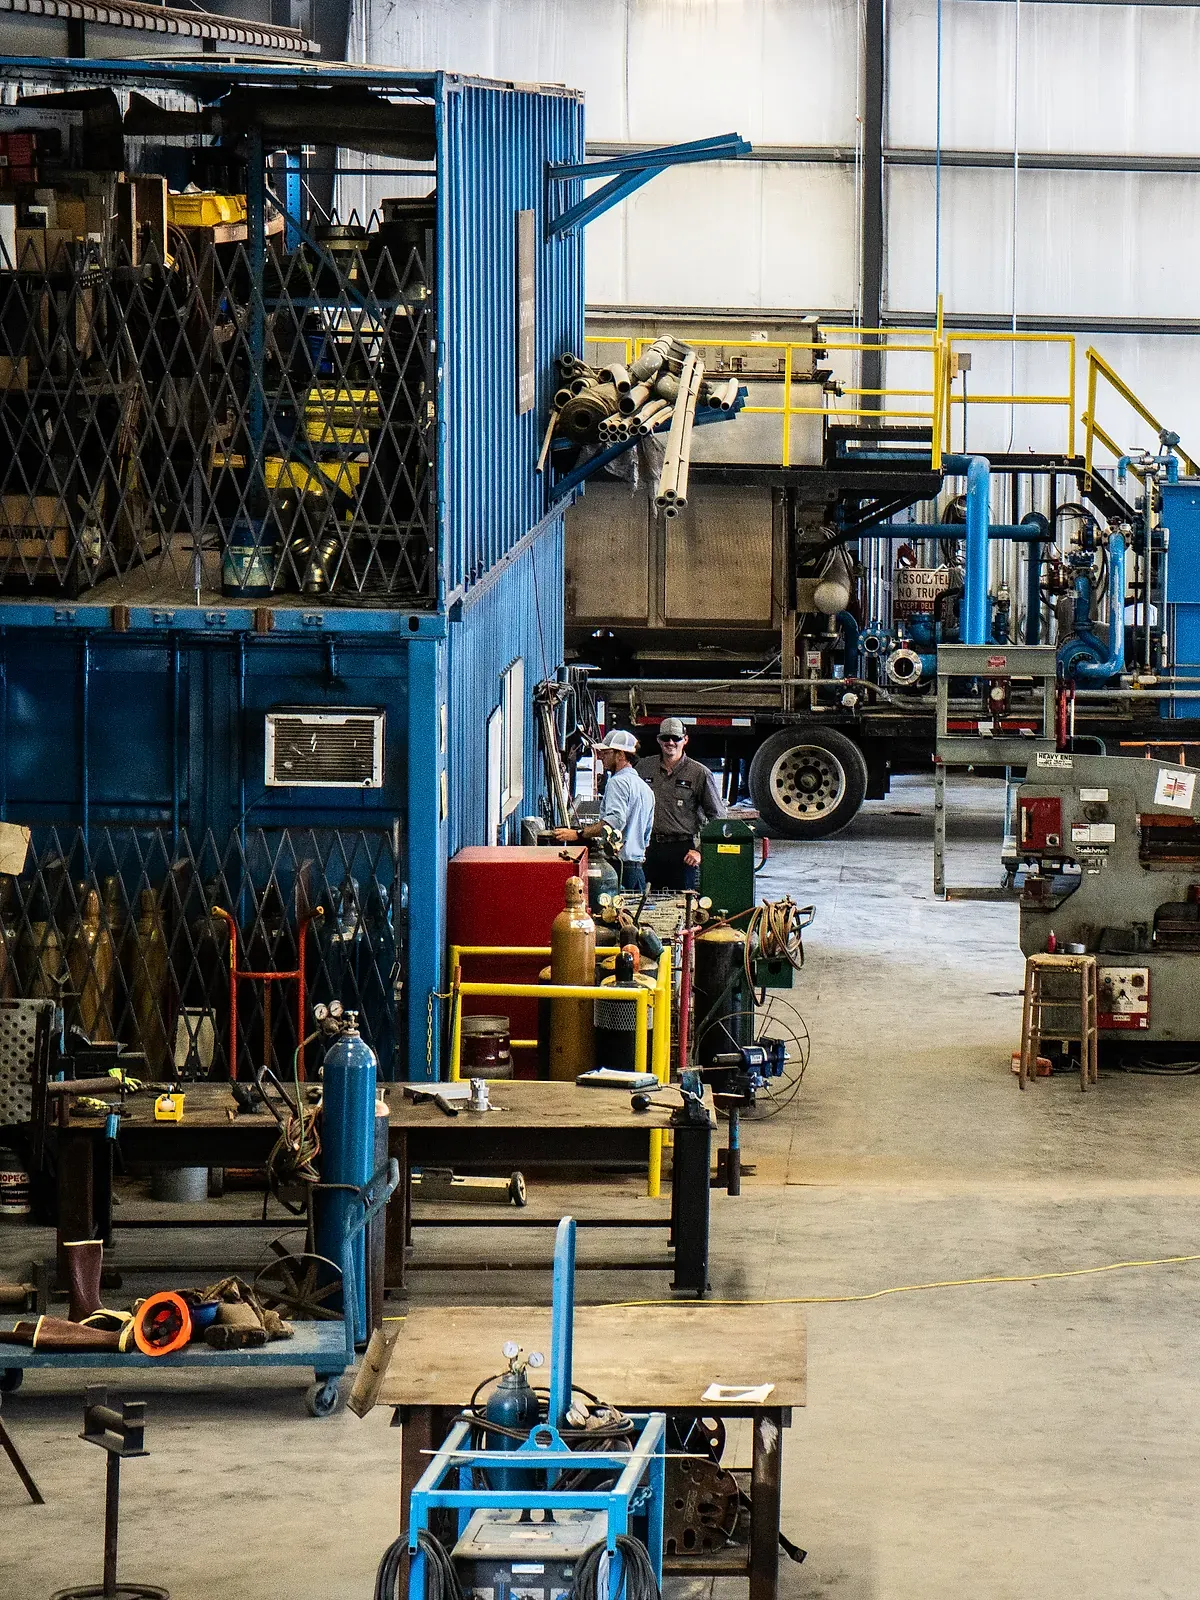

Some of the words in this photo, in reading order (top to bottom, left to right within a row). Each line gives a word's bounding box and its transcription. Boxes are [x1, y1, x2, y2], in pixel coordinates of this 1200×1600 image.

[0, 108, 19, 116] PSON
[897, 573, 950, 585] ABSOLUTEL
[898, 587, 912, 598] NO
[0, 1174, 26, 1182] OPEC
